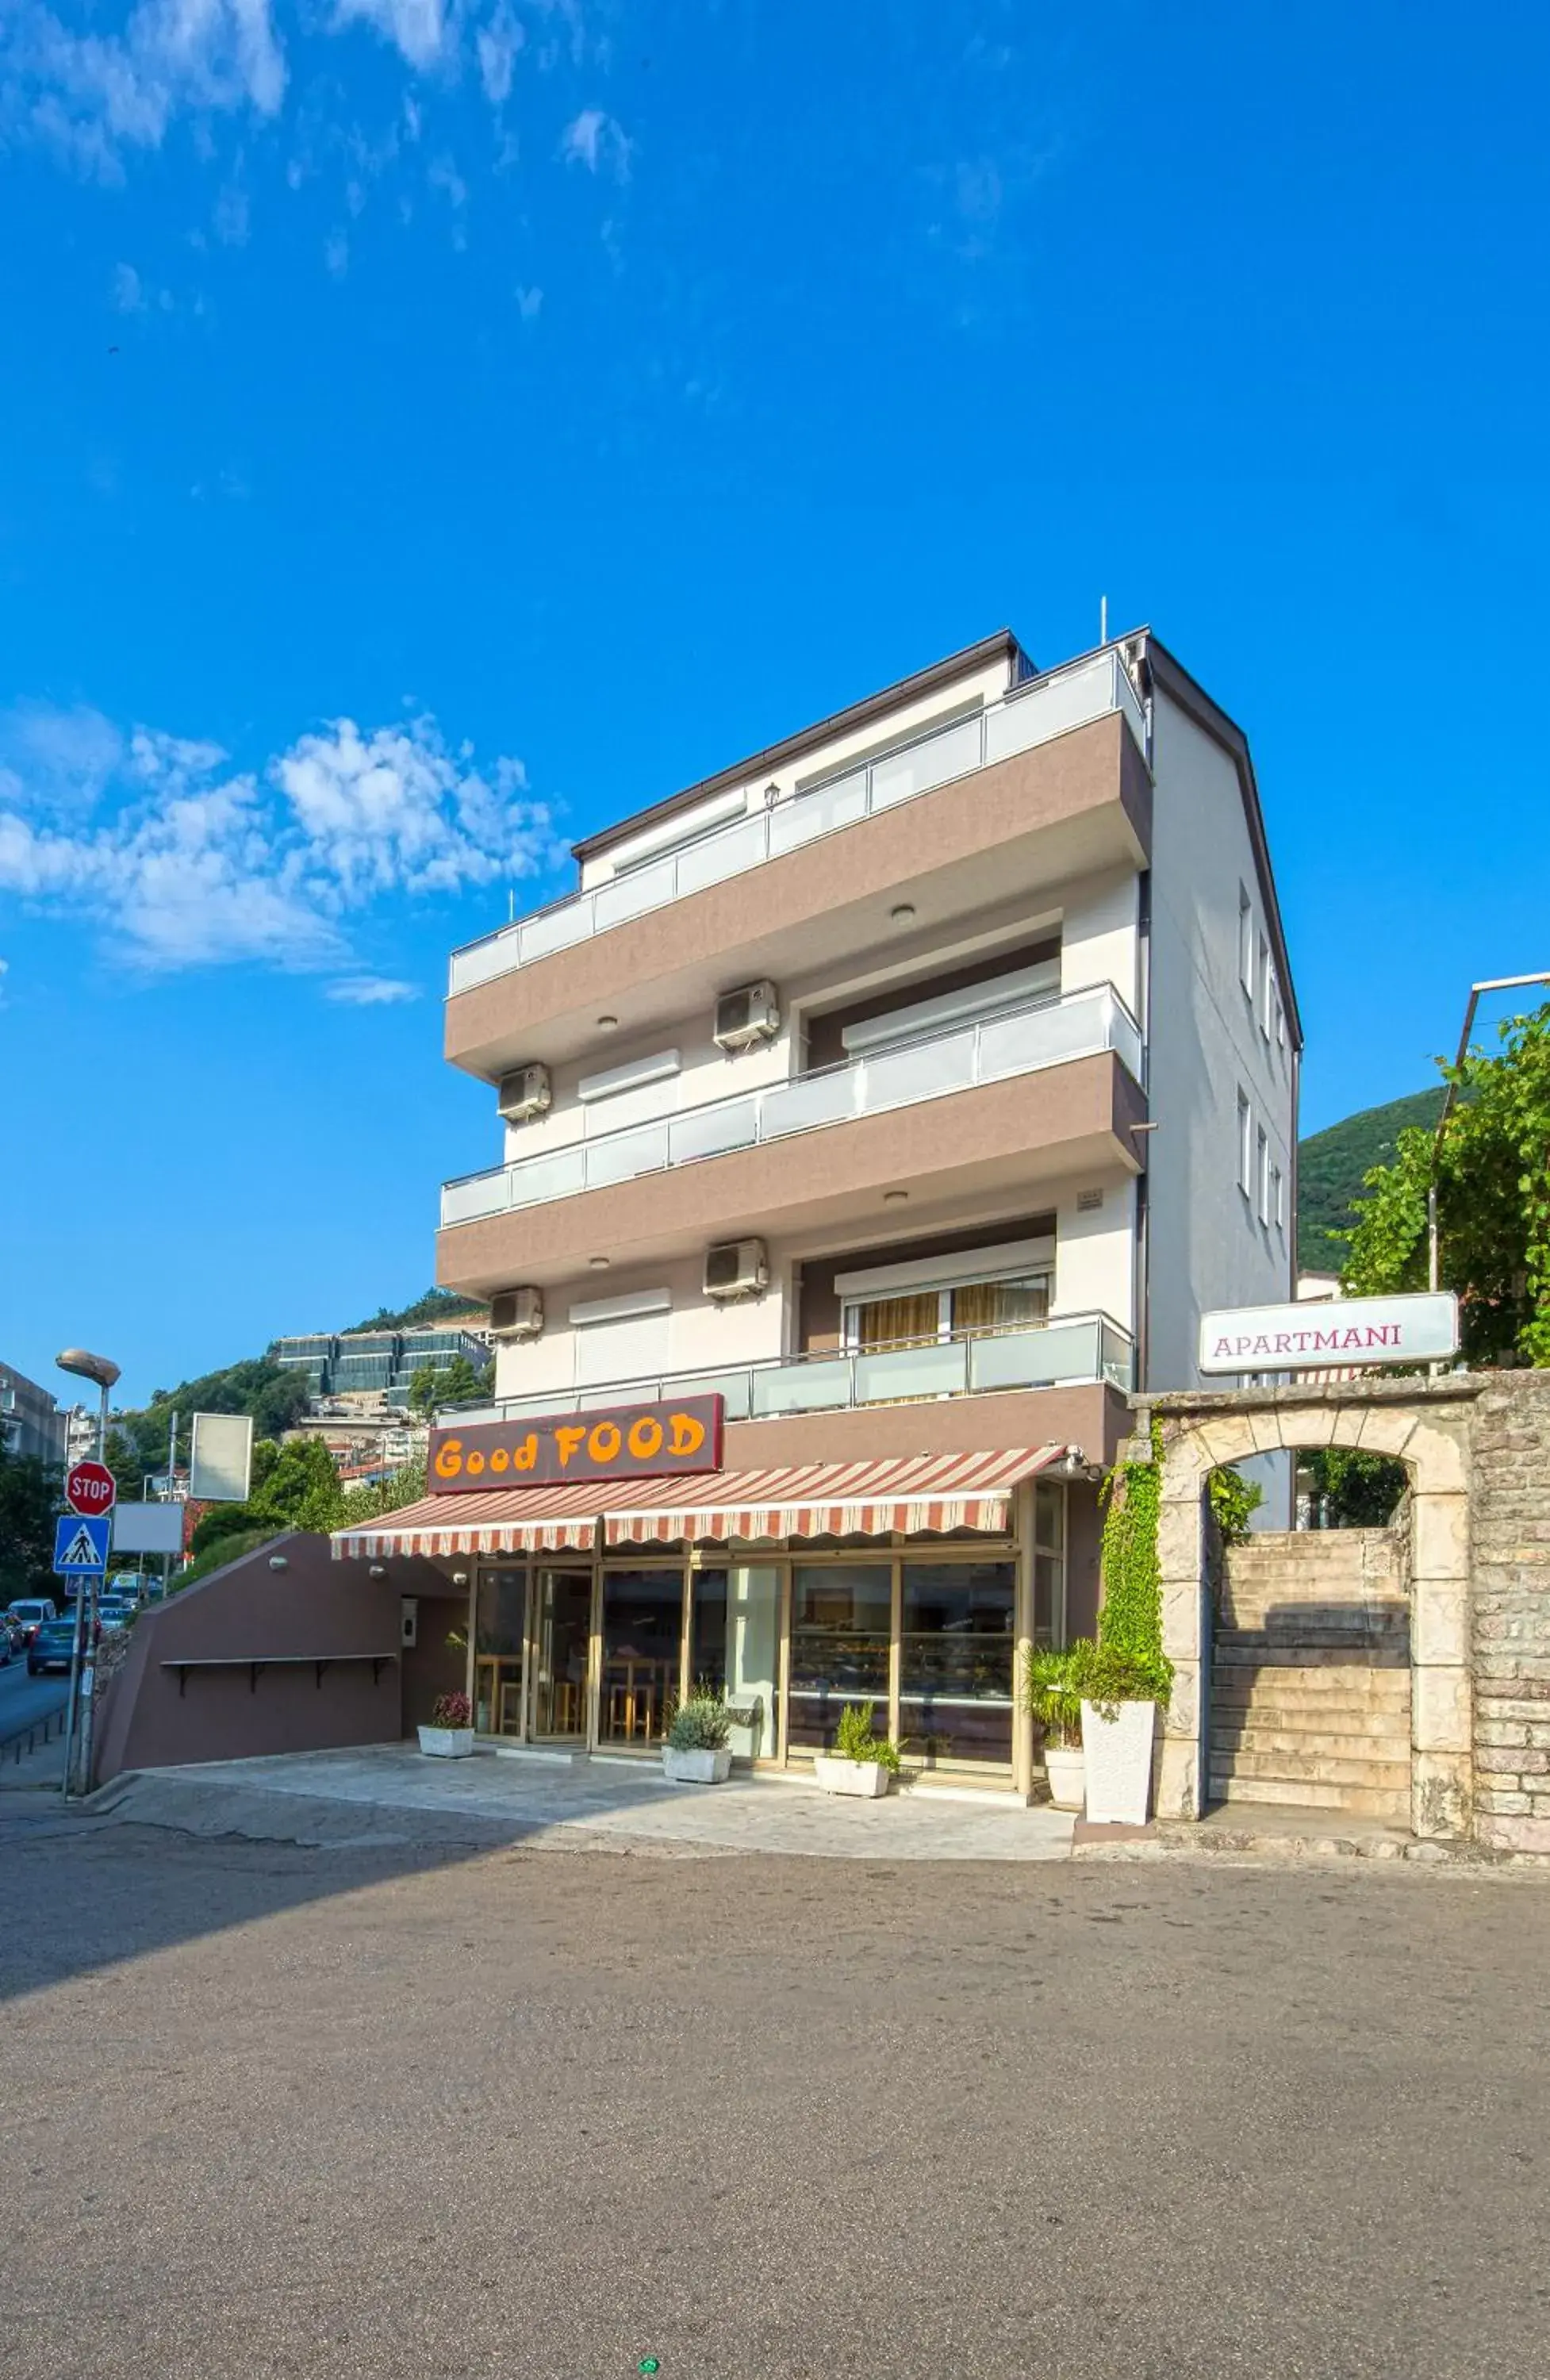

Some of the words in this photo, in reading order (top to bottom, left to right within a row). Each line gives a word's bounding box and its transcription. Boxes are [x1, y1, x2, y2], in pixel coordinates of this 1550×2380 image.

[1212, 1324, 1402, 1357] APARTMANI
[435, 1434, 539, 1478] Good
[554, 1412, 706, 1468] FOOD
[72, 1476, 110, 1500] STOP
